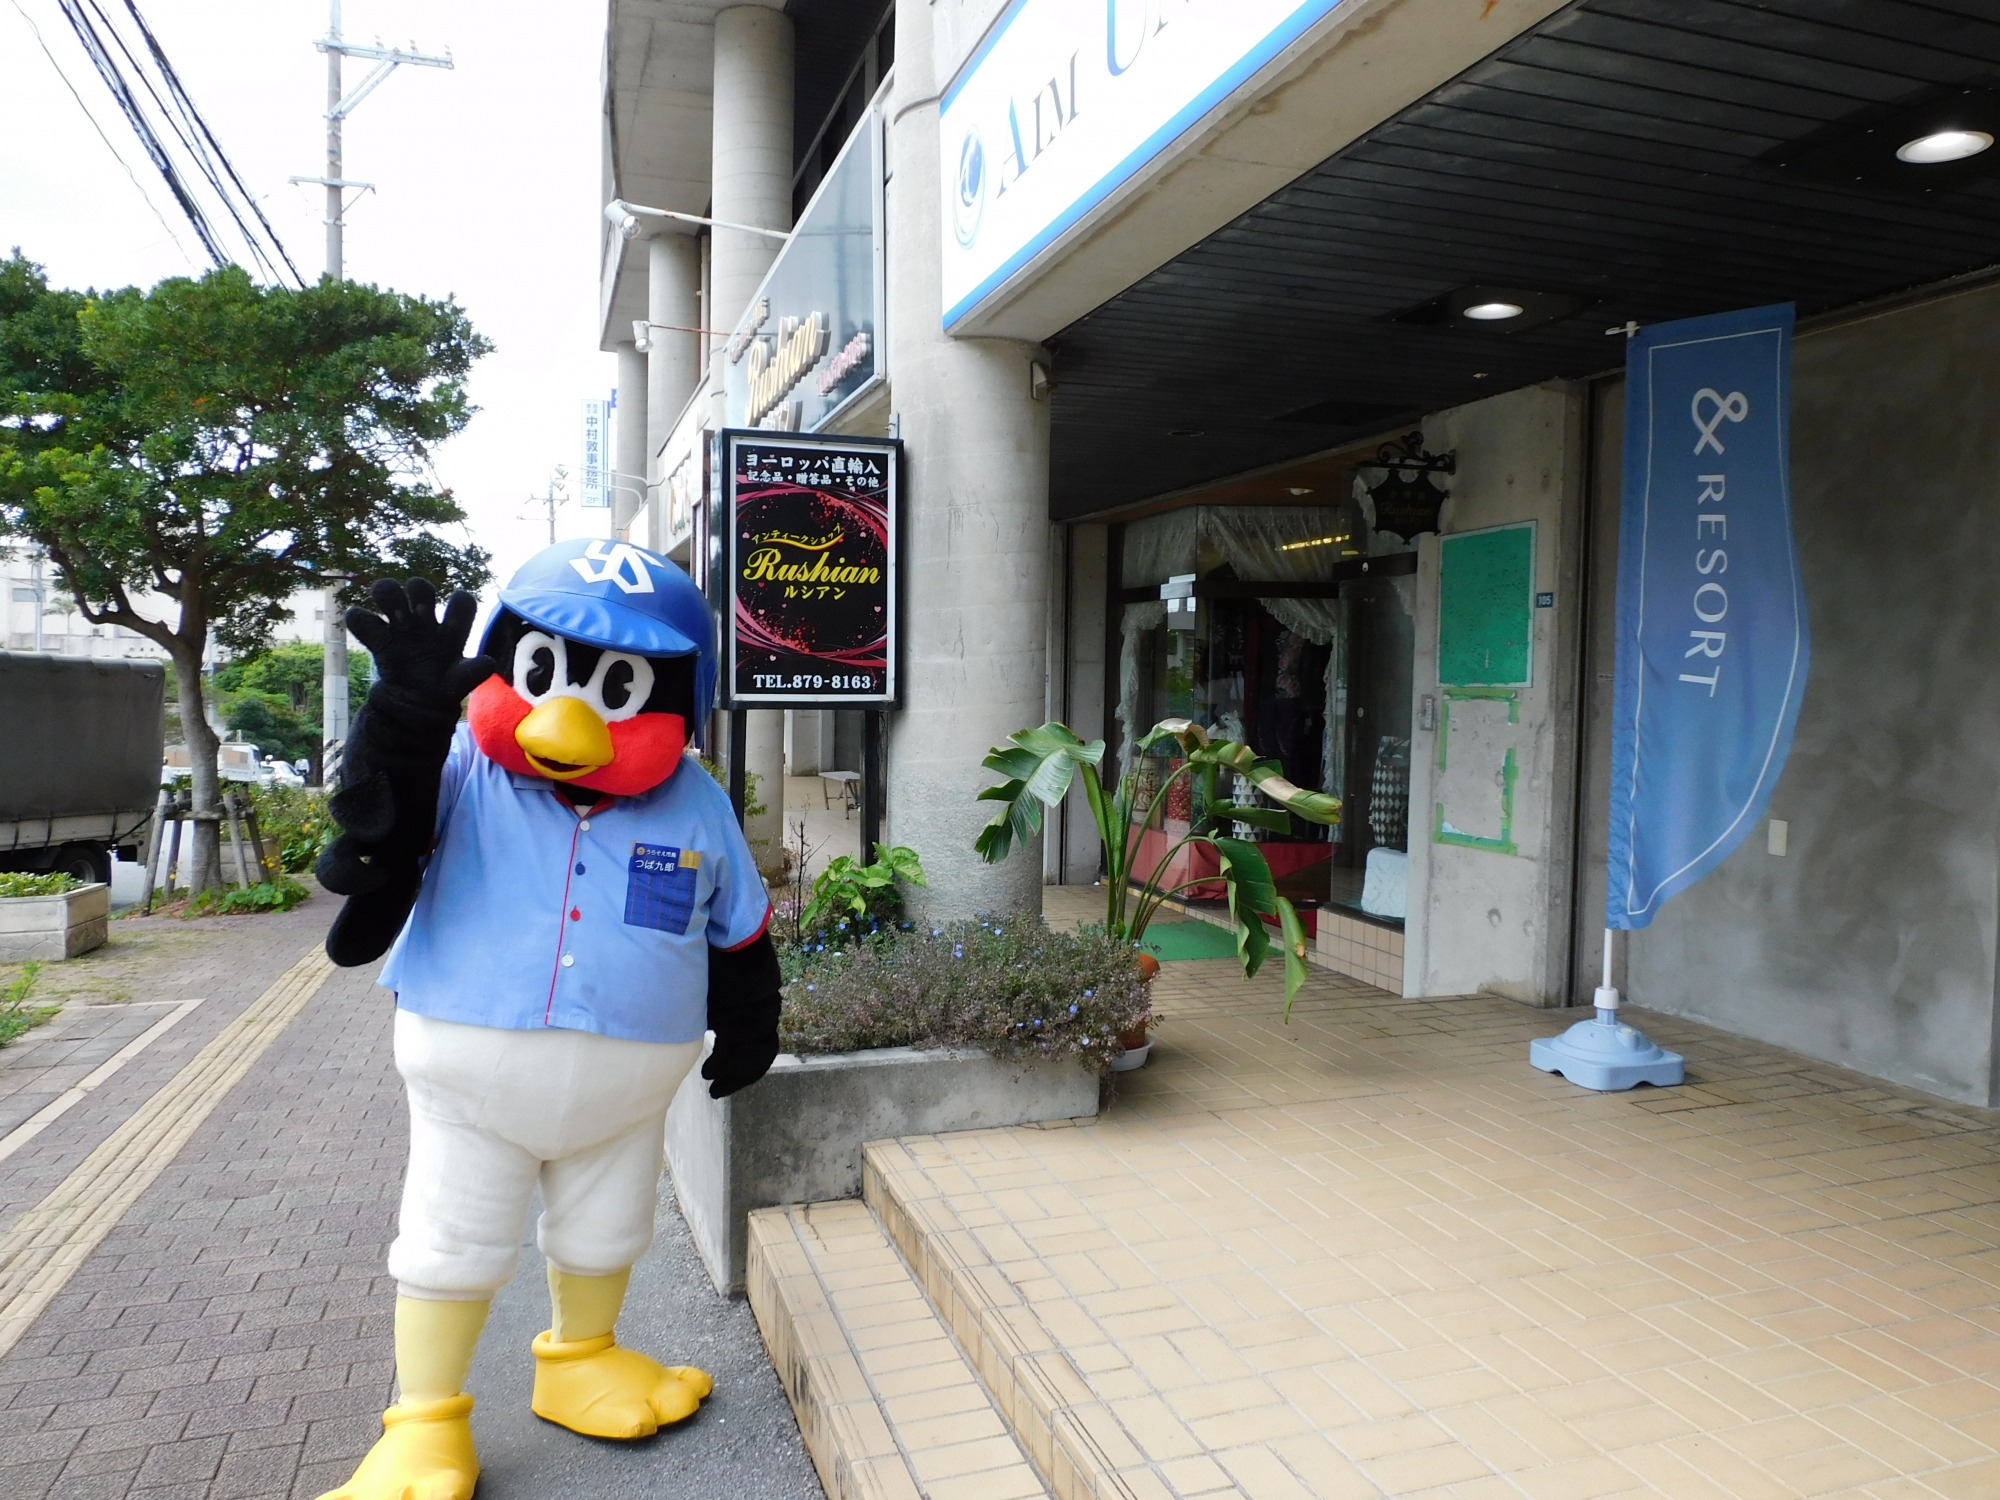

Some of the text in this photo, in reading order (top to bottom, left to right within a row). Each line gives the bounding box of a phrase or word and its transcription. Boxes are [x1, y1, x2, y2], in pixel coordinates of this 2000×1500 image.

[997, 48, 1080, 199] AIM
[745, 453, 881, 474] ヨーロッパ直輸入
[747, 469, 880, 488] 記念品・贈答品・その他
[751, 522, 844, 545] アンティークショップ
[1679, 387, 1749, 697] & RESORT
[743, 548, 881, 584] Rushian
[784, 585, 846, 600] ルシアン
[753, 674, 871, 689] TEL.879-8163
[634, 859, 675, 873] つば九郎
